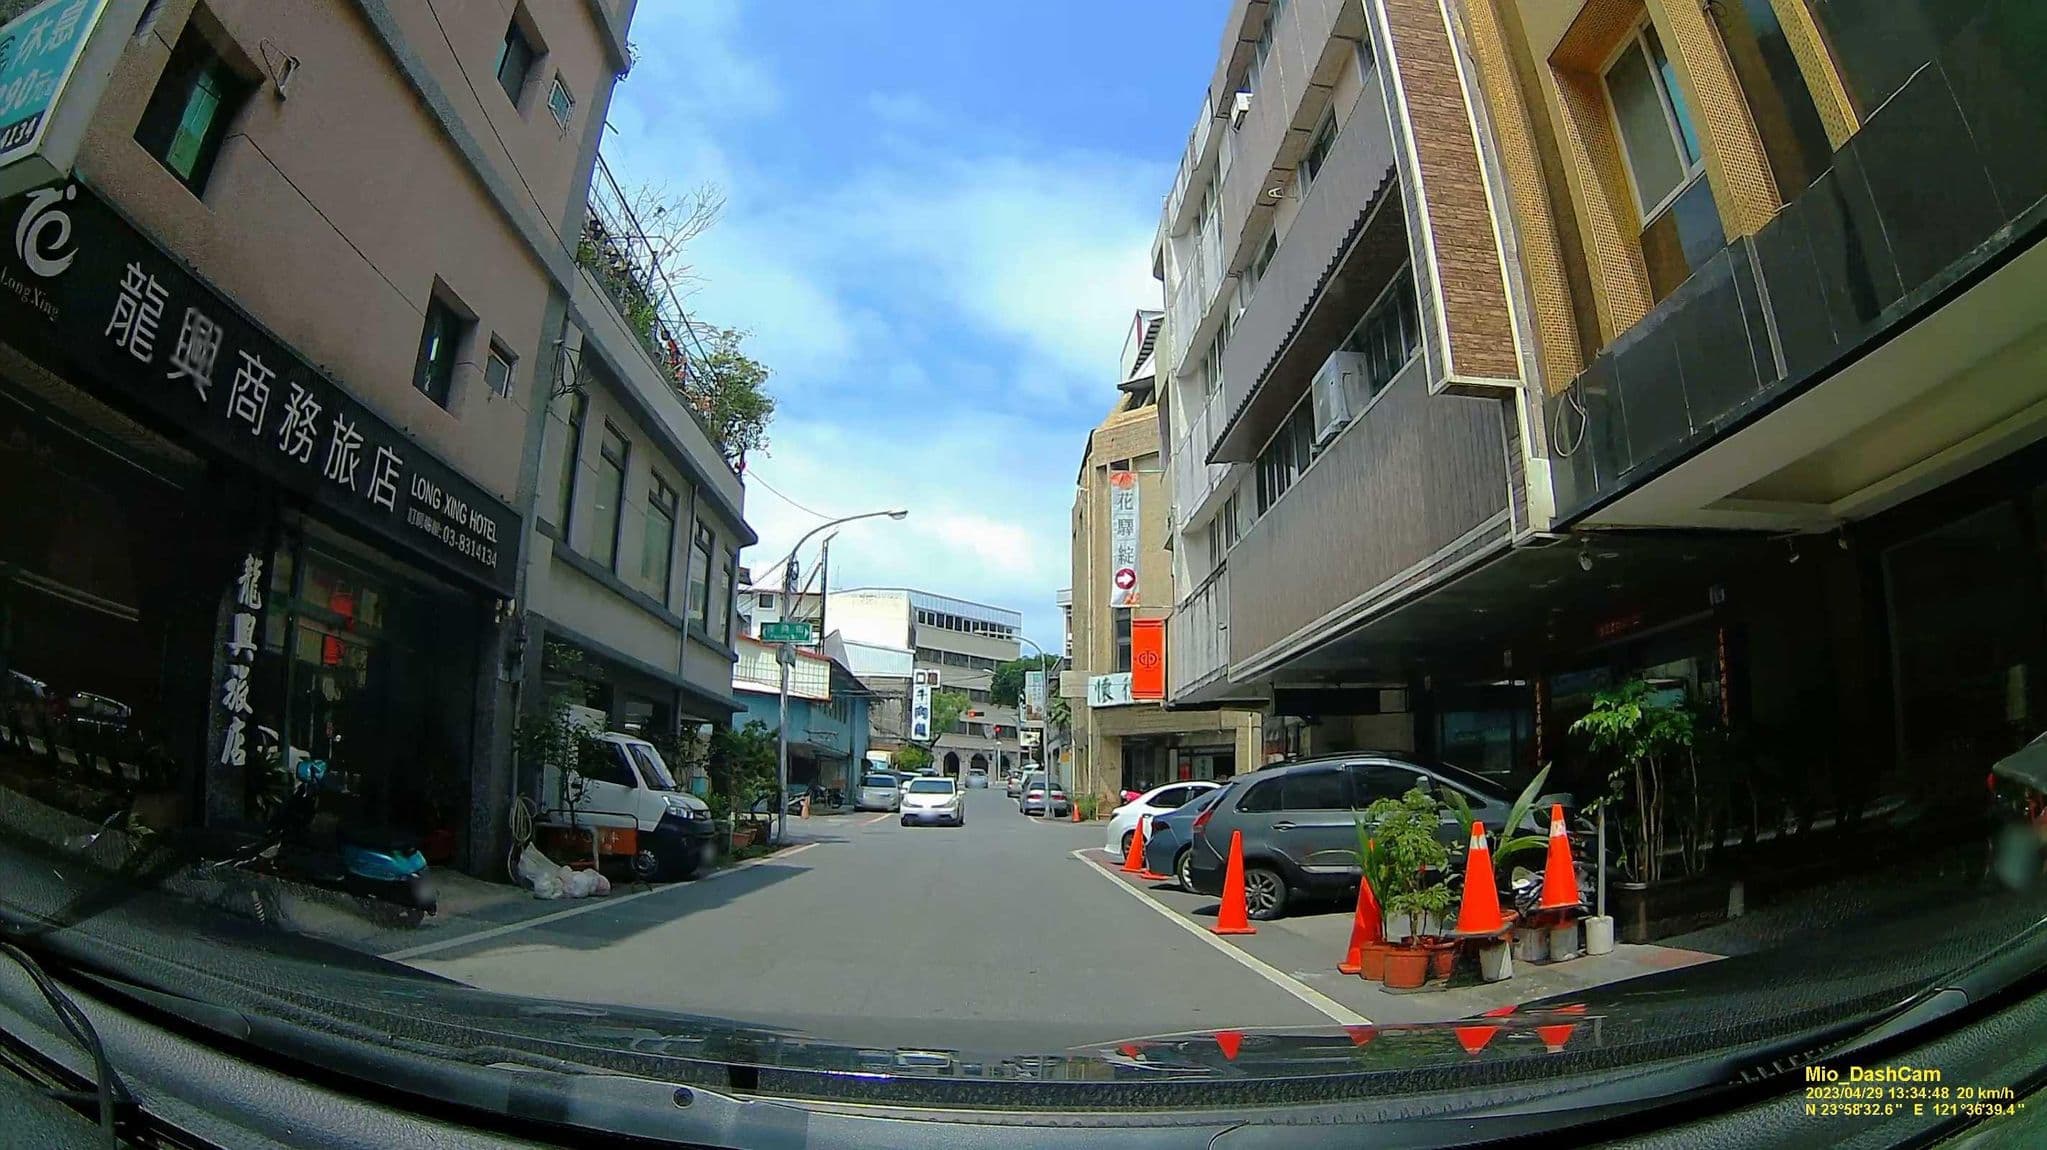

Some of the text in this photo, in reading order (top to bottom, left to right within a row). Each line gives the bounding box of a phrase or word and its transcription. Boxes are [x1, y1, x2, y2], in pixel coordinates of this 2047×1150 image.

[105, 262, 404, 513] 龍興商務旅店
[411, 473, 498, 543] LONG XING HOTEL
[443, 525, 498, 568] 03-8314134
